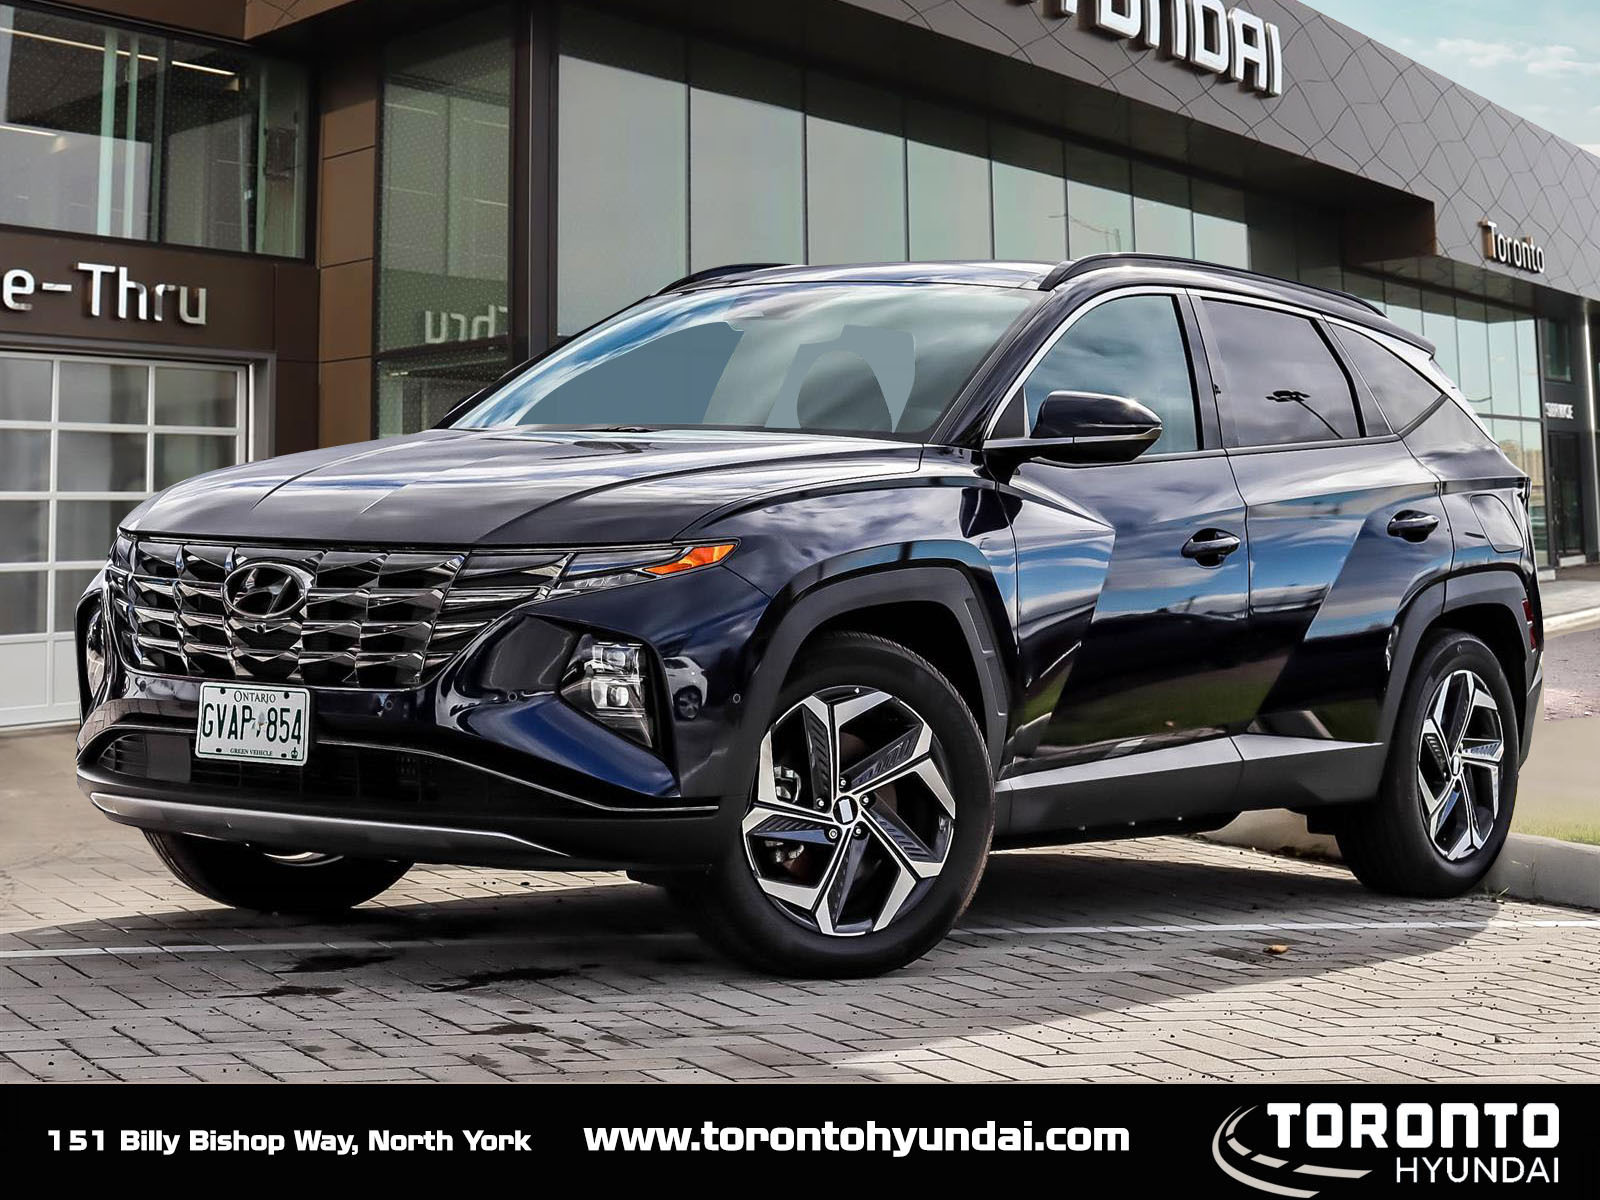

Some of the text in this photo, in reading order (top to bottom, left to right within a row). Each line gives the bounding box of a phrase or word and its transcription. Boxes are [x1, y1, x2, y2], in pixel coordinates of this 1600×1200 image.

[1062, 0, 1282, 97] UNDAI
[1482, 218, 1545, 273] Toronto
[3, 262, 207, 326] e-Thru
[233, 691, 276, 704] ONTARIO
[202, 703, 301, 744] GVAP 854
[249, 749, 273, 757] VEHICLE
